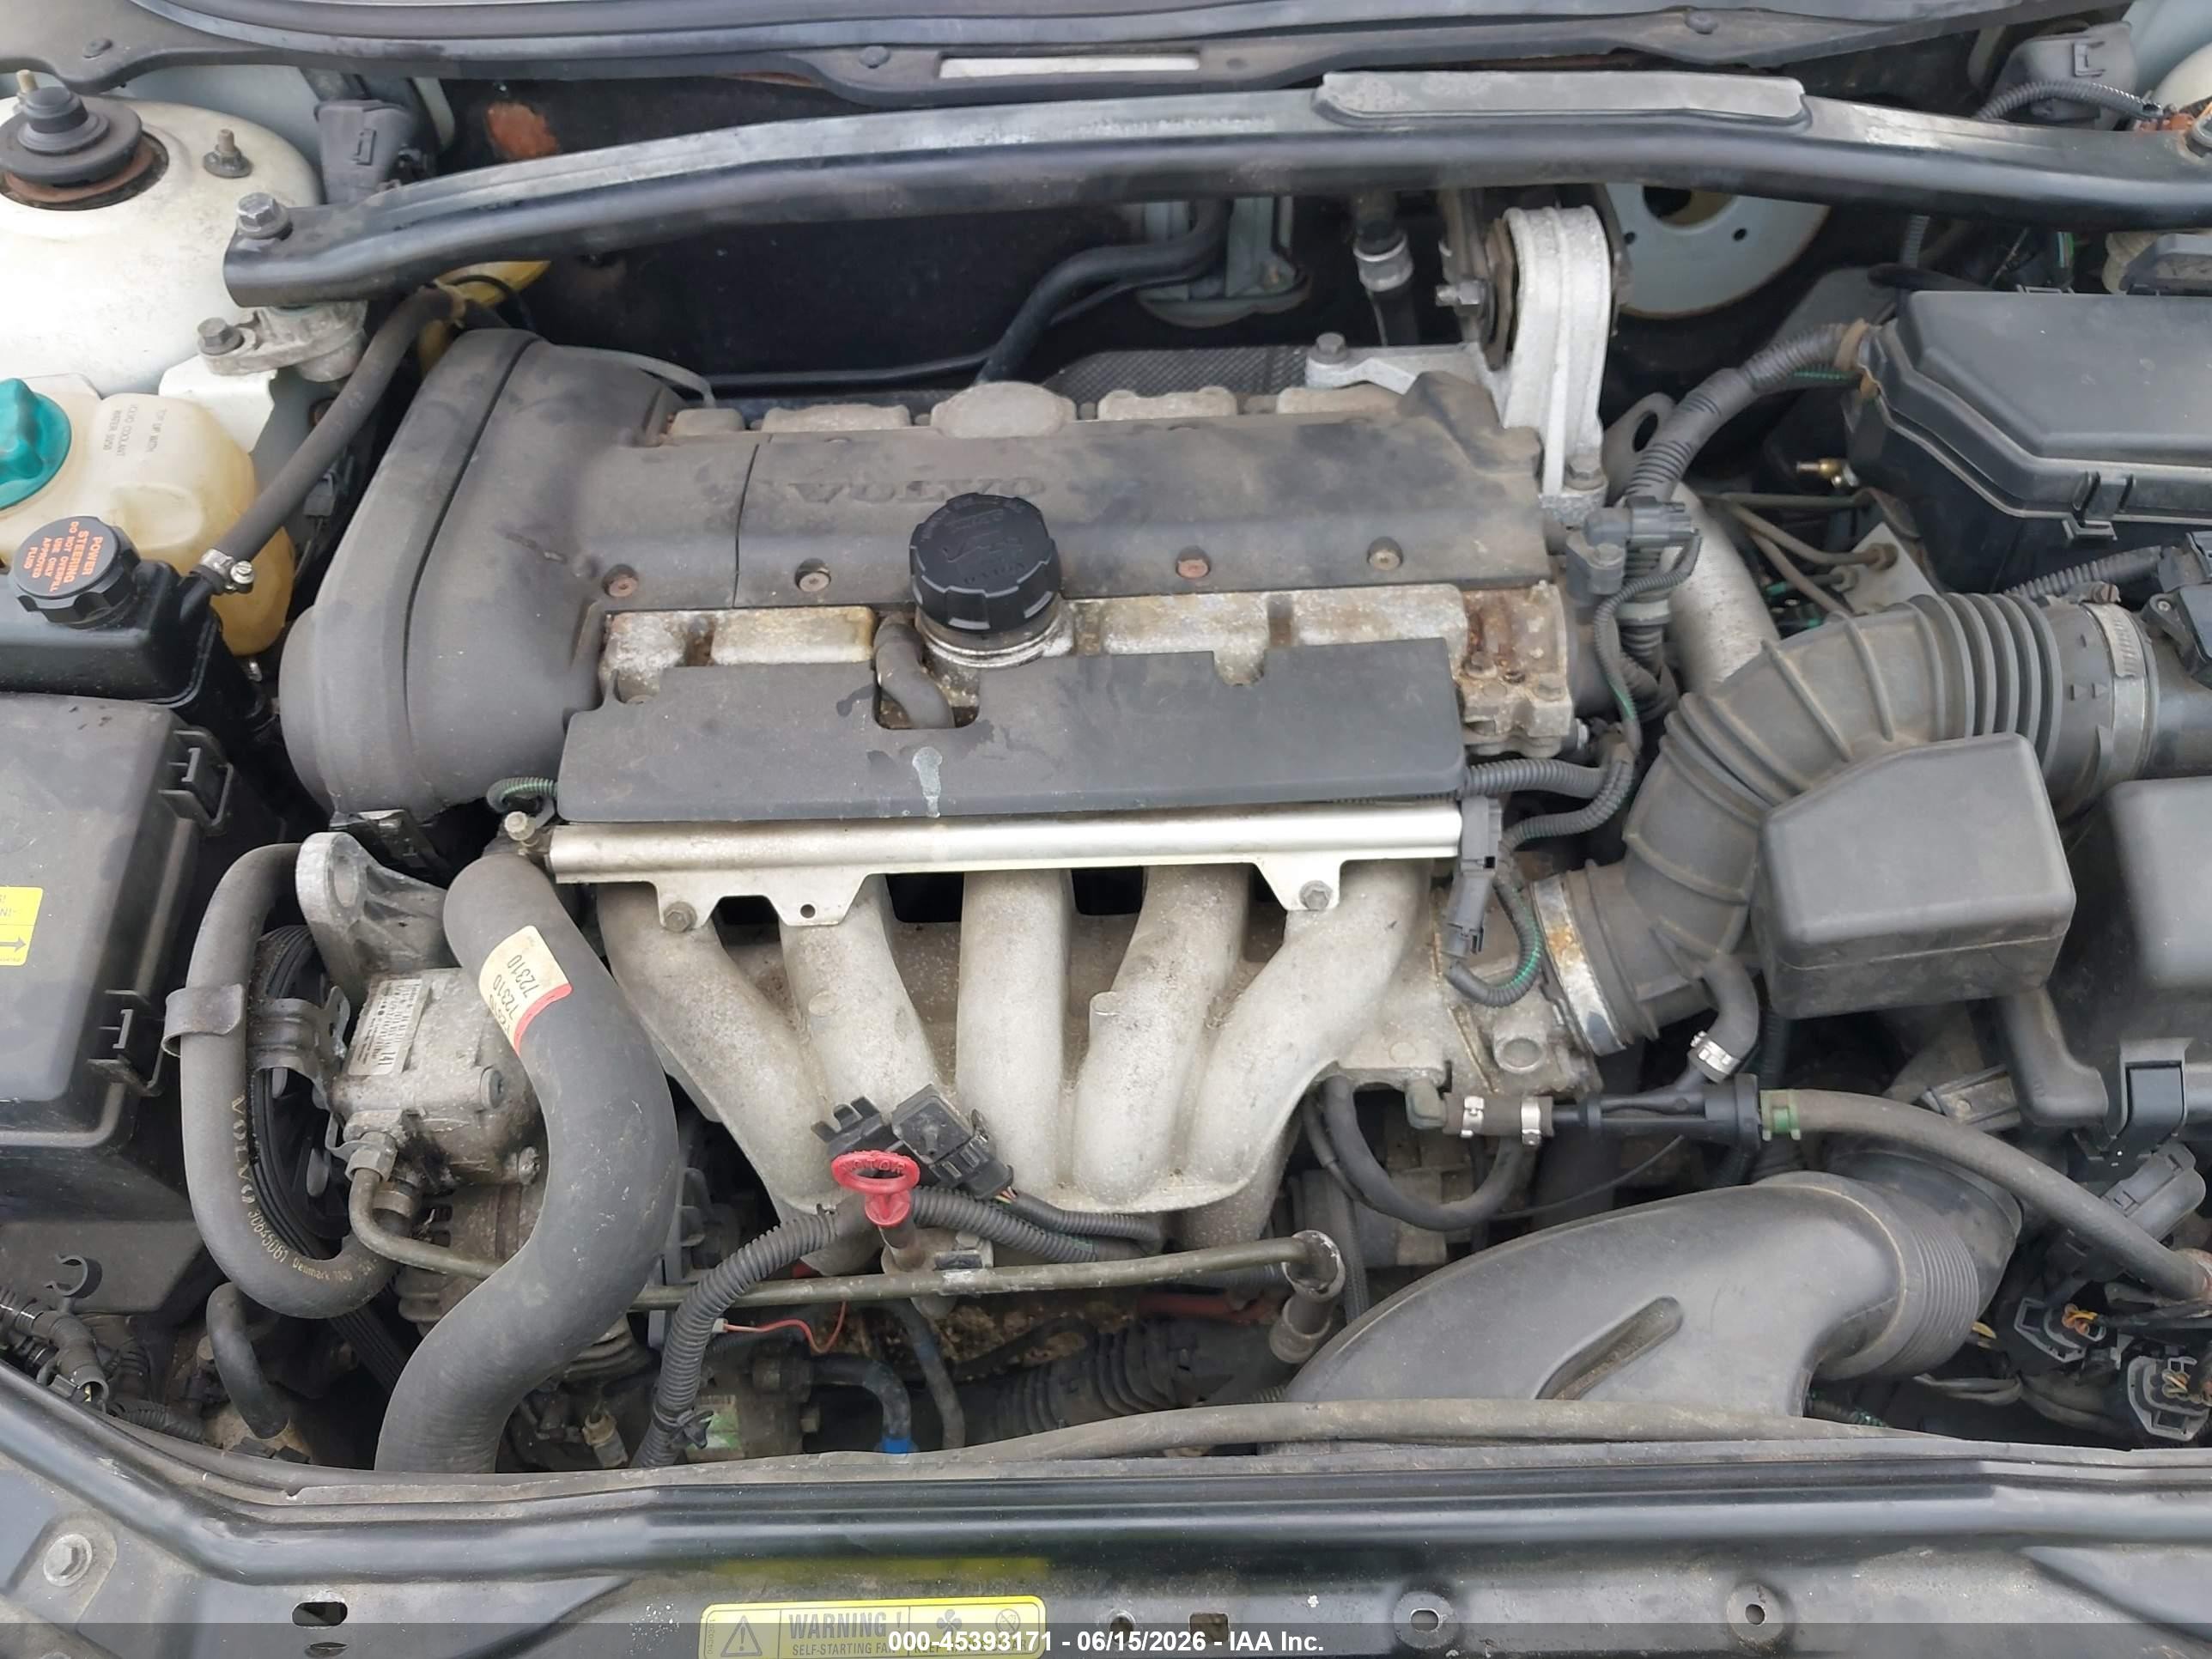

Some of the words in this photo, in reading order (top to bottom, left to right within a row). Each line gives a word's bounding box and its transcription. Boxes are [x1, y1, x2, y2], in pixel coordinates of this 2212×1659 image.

[69, 521, 79, 533] DO
[23, 547, 39, 569] FLUID
[32, 538, 52, 578] APPROVED
[52, 538, 64, 553] USE
[63, 531, 89, 583] STEERING
[64, 536, 75, 552] NOT
[82, 537, 103, 575] POWER
[45, 557, 57, 577] ONLY
[50, 556, 69, 592] OVERFILL
[507, 954, 539, 999] 72310
[493, 974, 520, 1020] 72310
[232, 1095, 256, 1204] VOLVO
[292, 1256, 331, 1281] Denmark
[788, 1612, 887, 1639] WARNING
[793, 1642, 872, 1656] SELF-STARTING
